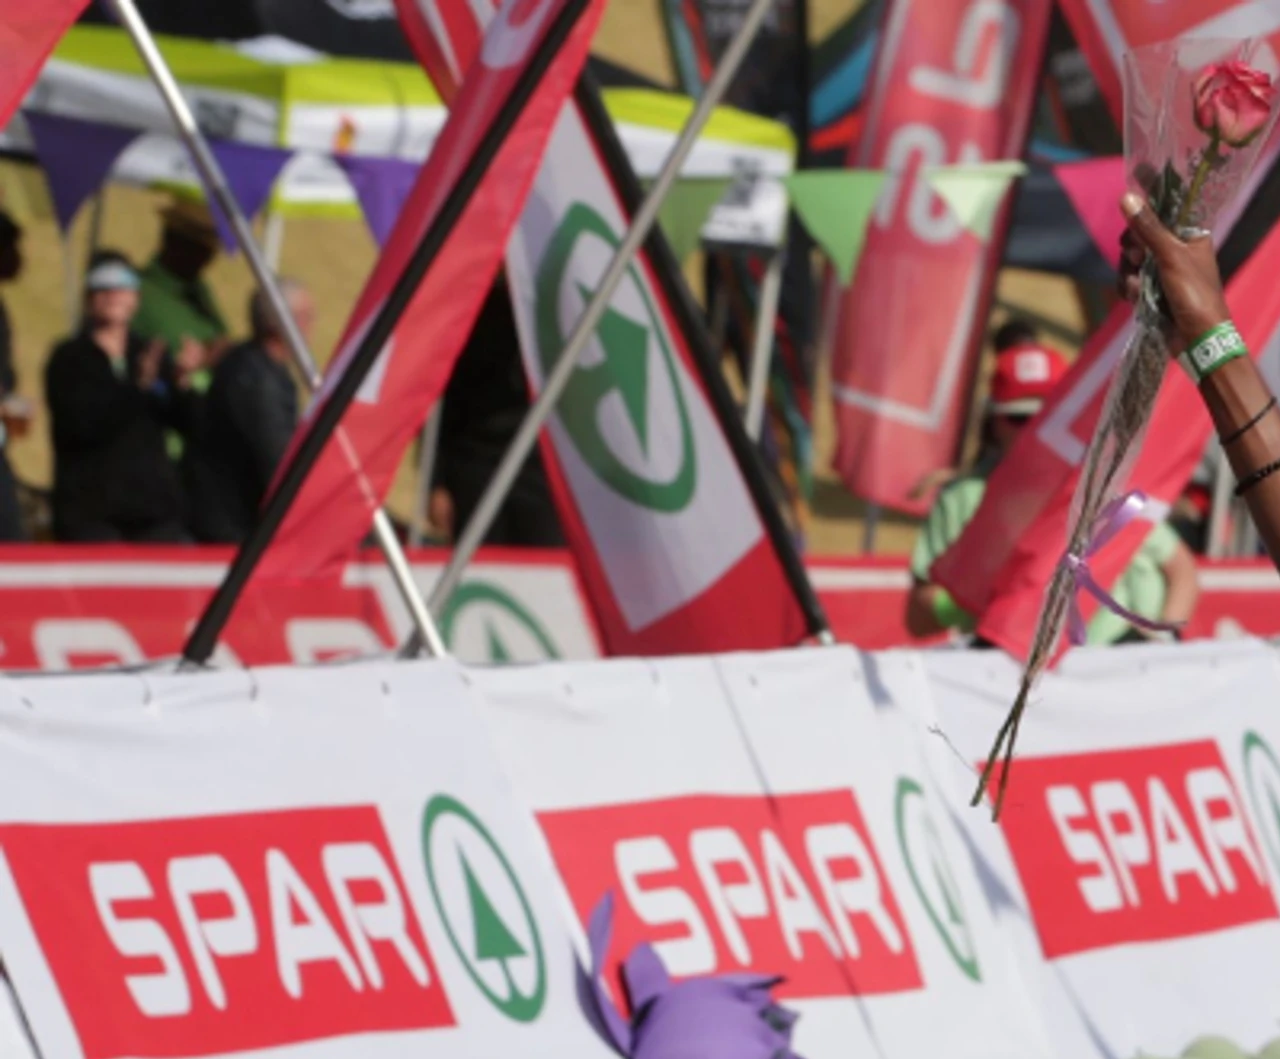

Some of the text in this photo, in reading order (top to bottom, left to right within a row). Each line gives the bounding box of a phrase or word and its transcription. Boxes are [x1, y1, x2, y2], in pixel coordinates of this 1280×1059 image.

[612, 822, 904, 977] SPAR
[1044, 766, 1270, 914] SPAR
[88, 840, 431, 1017] SPAR
